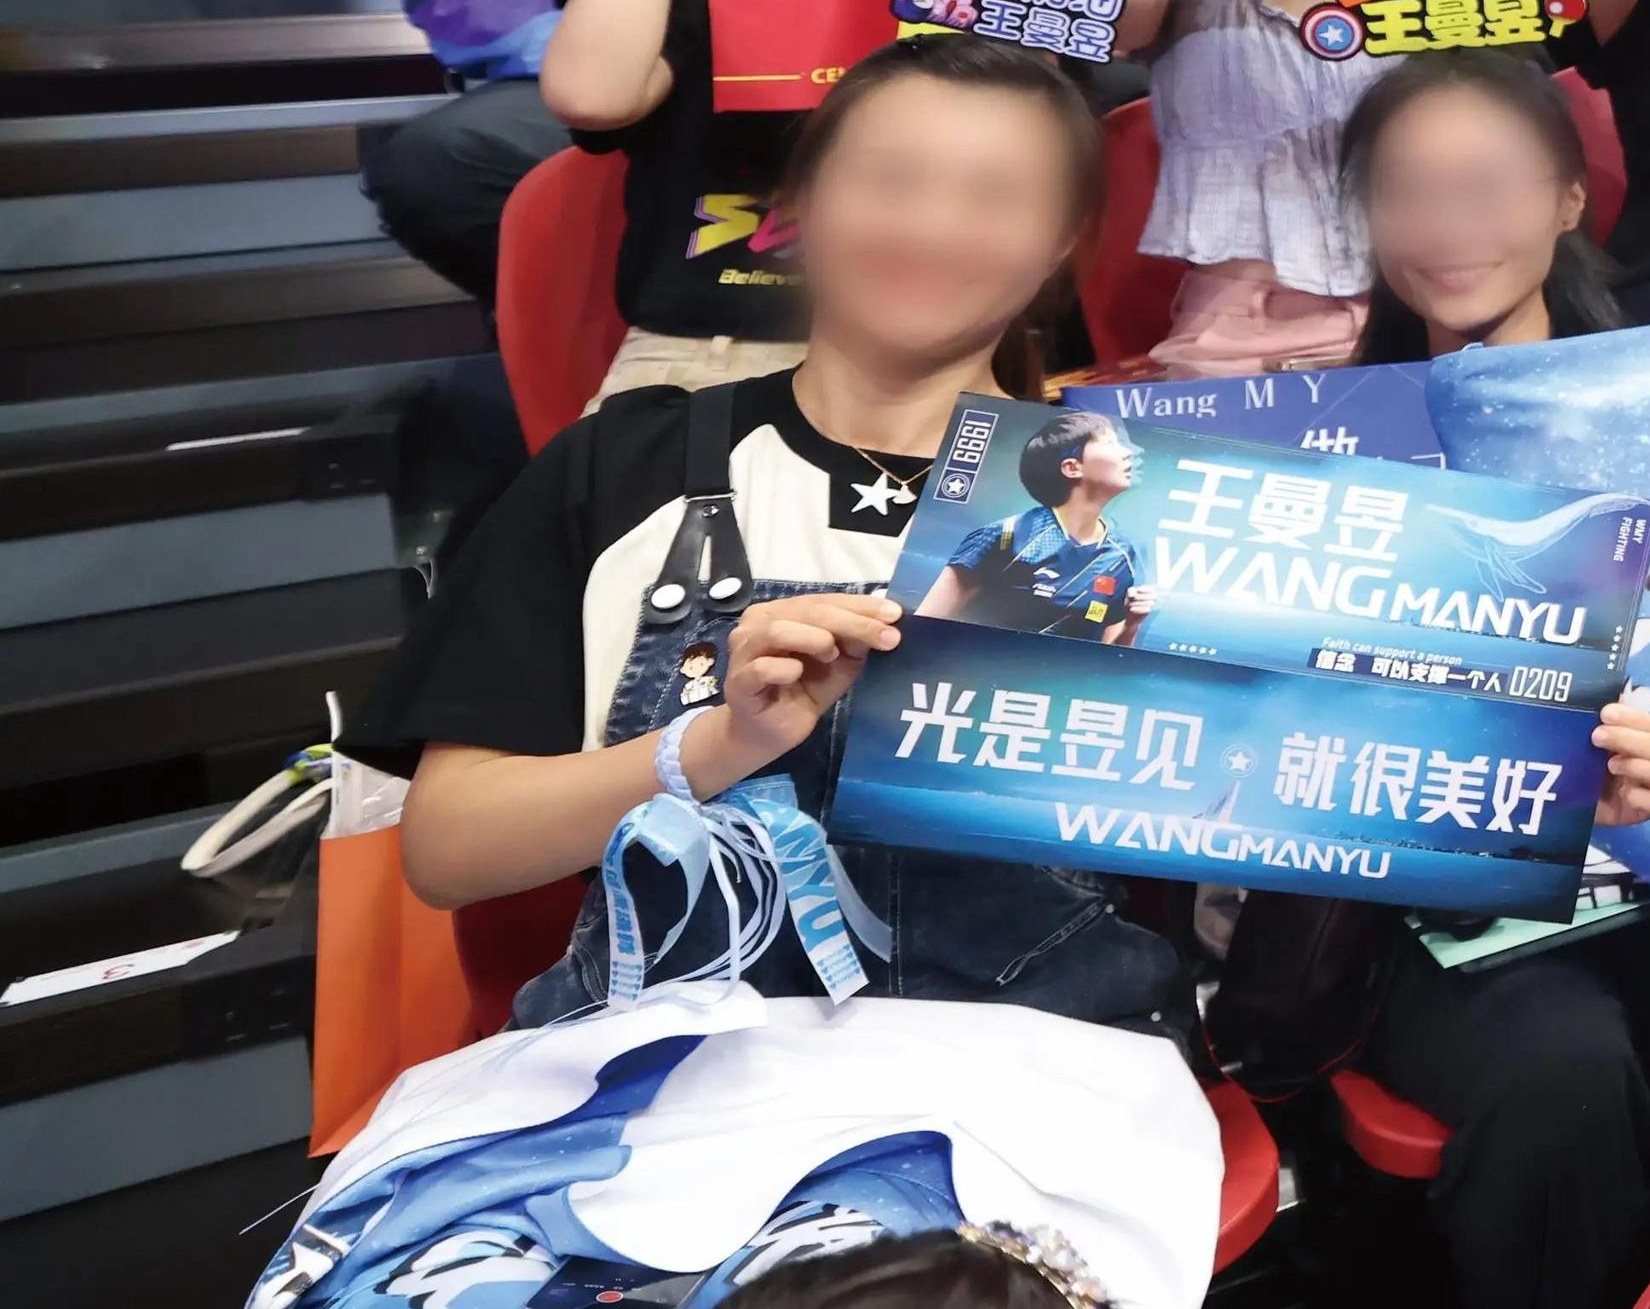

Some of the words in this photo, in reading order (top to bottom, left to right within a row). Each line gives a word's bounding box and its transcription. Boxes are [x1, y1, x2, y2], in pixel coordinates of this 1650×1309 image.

[973, 0, 1116, 65] 王曼昱
[1116, 387, 1217, 420] Wang
[1246, 377, 1275, 410] M
[1303, 373, 1327, 403] Y
[953, 418, 991, 466] 1999
[1157, 458, 1409, 562] 王曼昱
[1633, 518, 1647, 548] WMY
[1612, 515, 1630, 563] FIGHTING
[1154, 536, 1390, 619] WANG
[1390, 581, 1587, 645] MANYU
[1315, 649, 1356, 673] 信念
[1321, 637, 1351, 651] Faith
[1353, 642, 1373, 654] can
[1373, 645, 1416, 660] support
[1425, 651, 1463, 666] person
[1508, 665, 1573, 703] 0209
[894, 680, 1206, 792] 光是昱见
[1273, 731, 1565, 839] 就很美好
